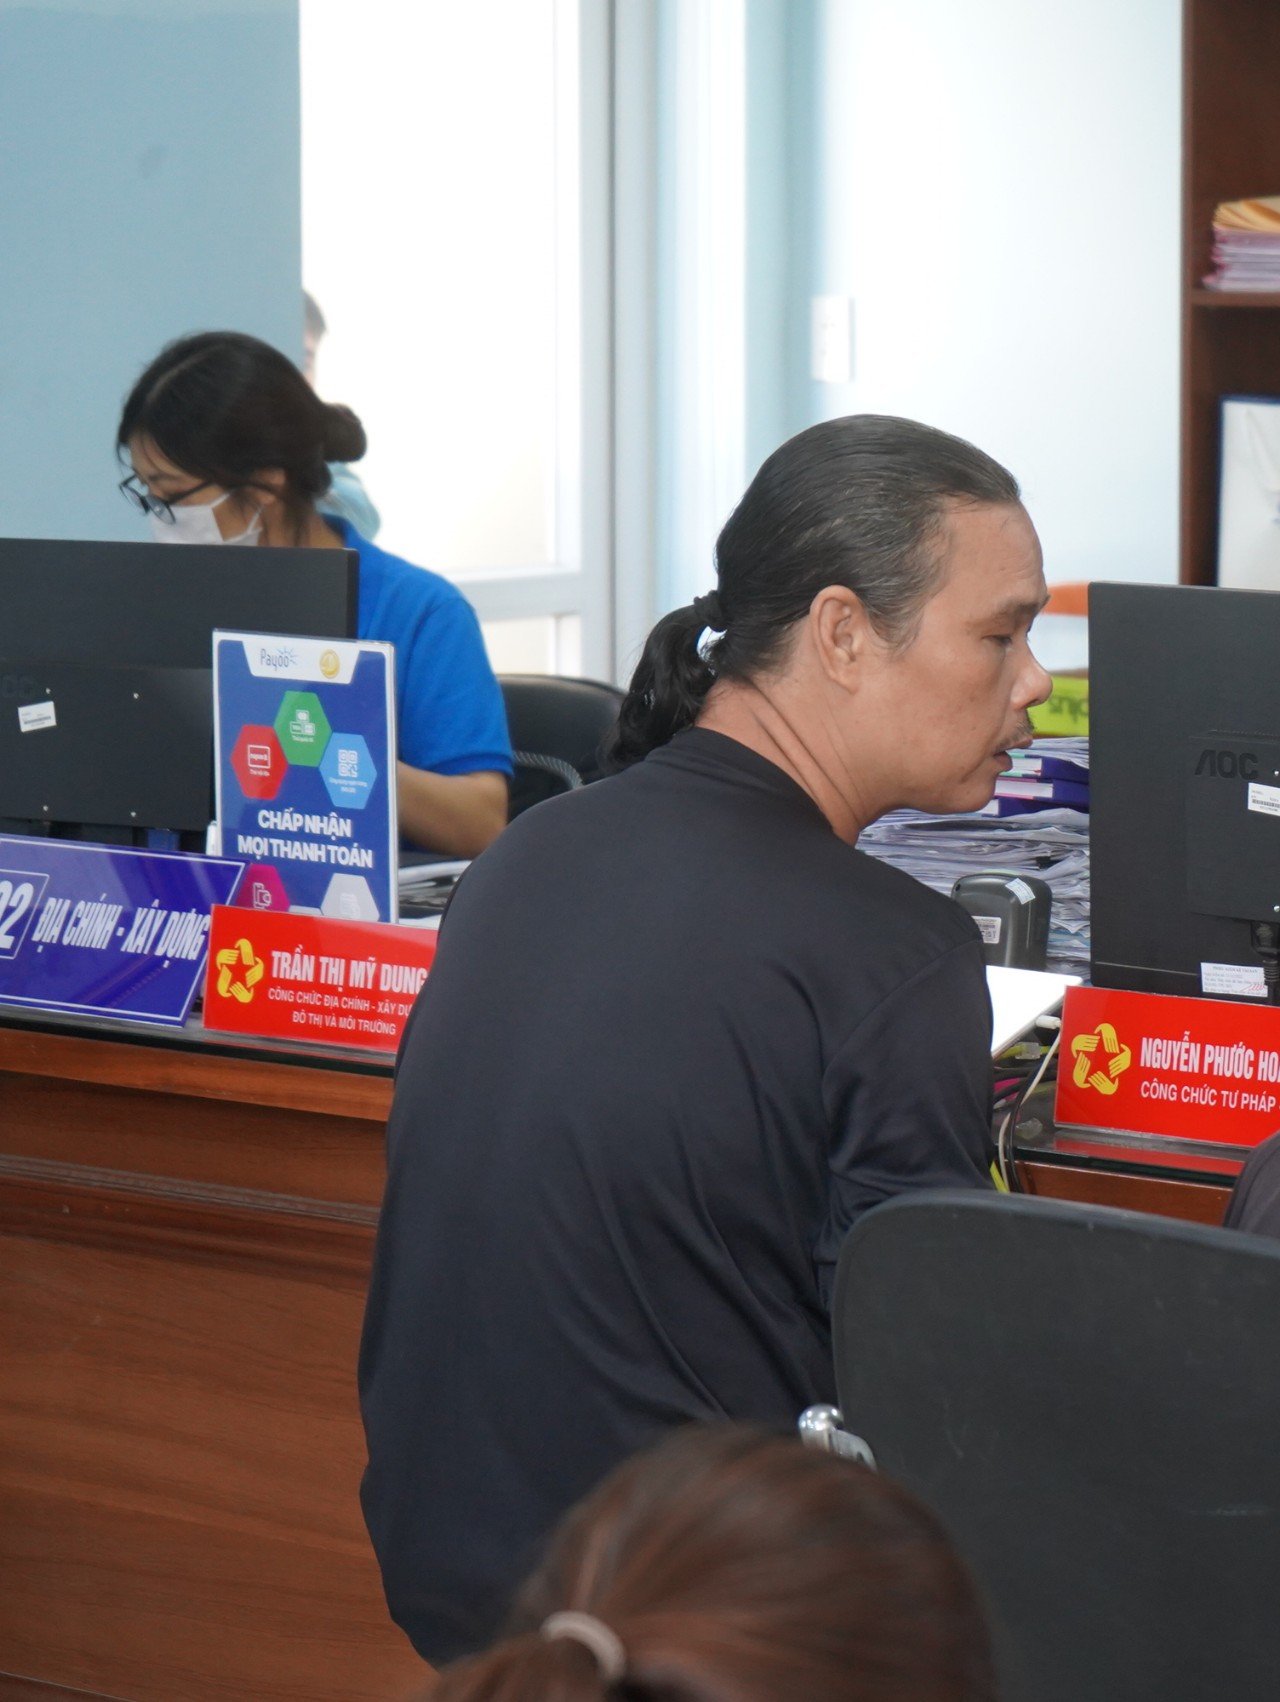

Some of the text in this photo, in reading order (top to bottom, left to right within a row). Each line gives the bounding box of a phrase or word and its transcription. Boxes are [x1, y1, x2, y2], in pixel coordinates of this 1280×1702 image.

[260, 648, 290, 672] Payoo
[1194, 749, 1258, 781] AOC
[257, 807, 352, 841] CHẤP NHẬN
[237, 834, 373, 868] MỌI THANH TOÁN
[31, 897, 68, 953] ĐỊA
[62, 893, 123, 950] CHÍNH
[121, 899, 167, 955] XÂY
[154, 908, 211, 968] DỰNG
[271, 944, 315, 982] TRẦN
[319, 957, 346, 992] THỊ
[349, 957, 379, 989] MỸ
[268, 986, 295, 1002] CÔNG
[296, 990, 322, 1006] CHỨC
[323, 995, 339, 1009] ĐỊA
[341, 996, 370, 1011] CHÍNH
[377, 999, 396, 1014] XÂY
[292, 1009, 396, 1036] ĐÔ THỊ VÀ MÔI TRƯỜNG
[1140, 1030, 1201, 1074] NGUYỄN
[1203, 1041, 1255, 1080] PHƯỚC
[1140, 1077, 1178, 1101] CÔNG
[1181, 1083, 1218, 1106] CHỨC
[1221, 1089, 1240, 1109] TƯ
[1241, 1091, 1277, 1113] PHÁP
